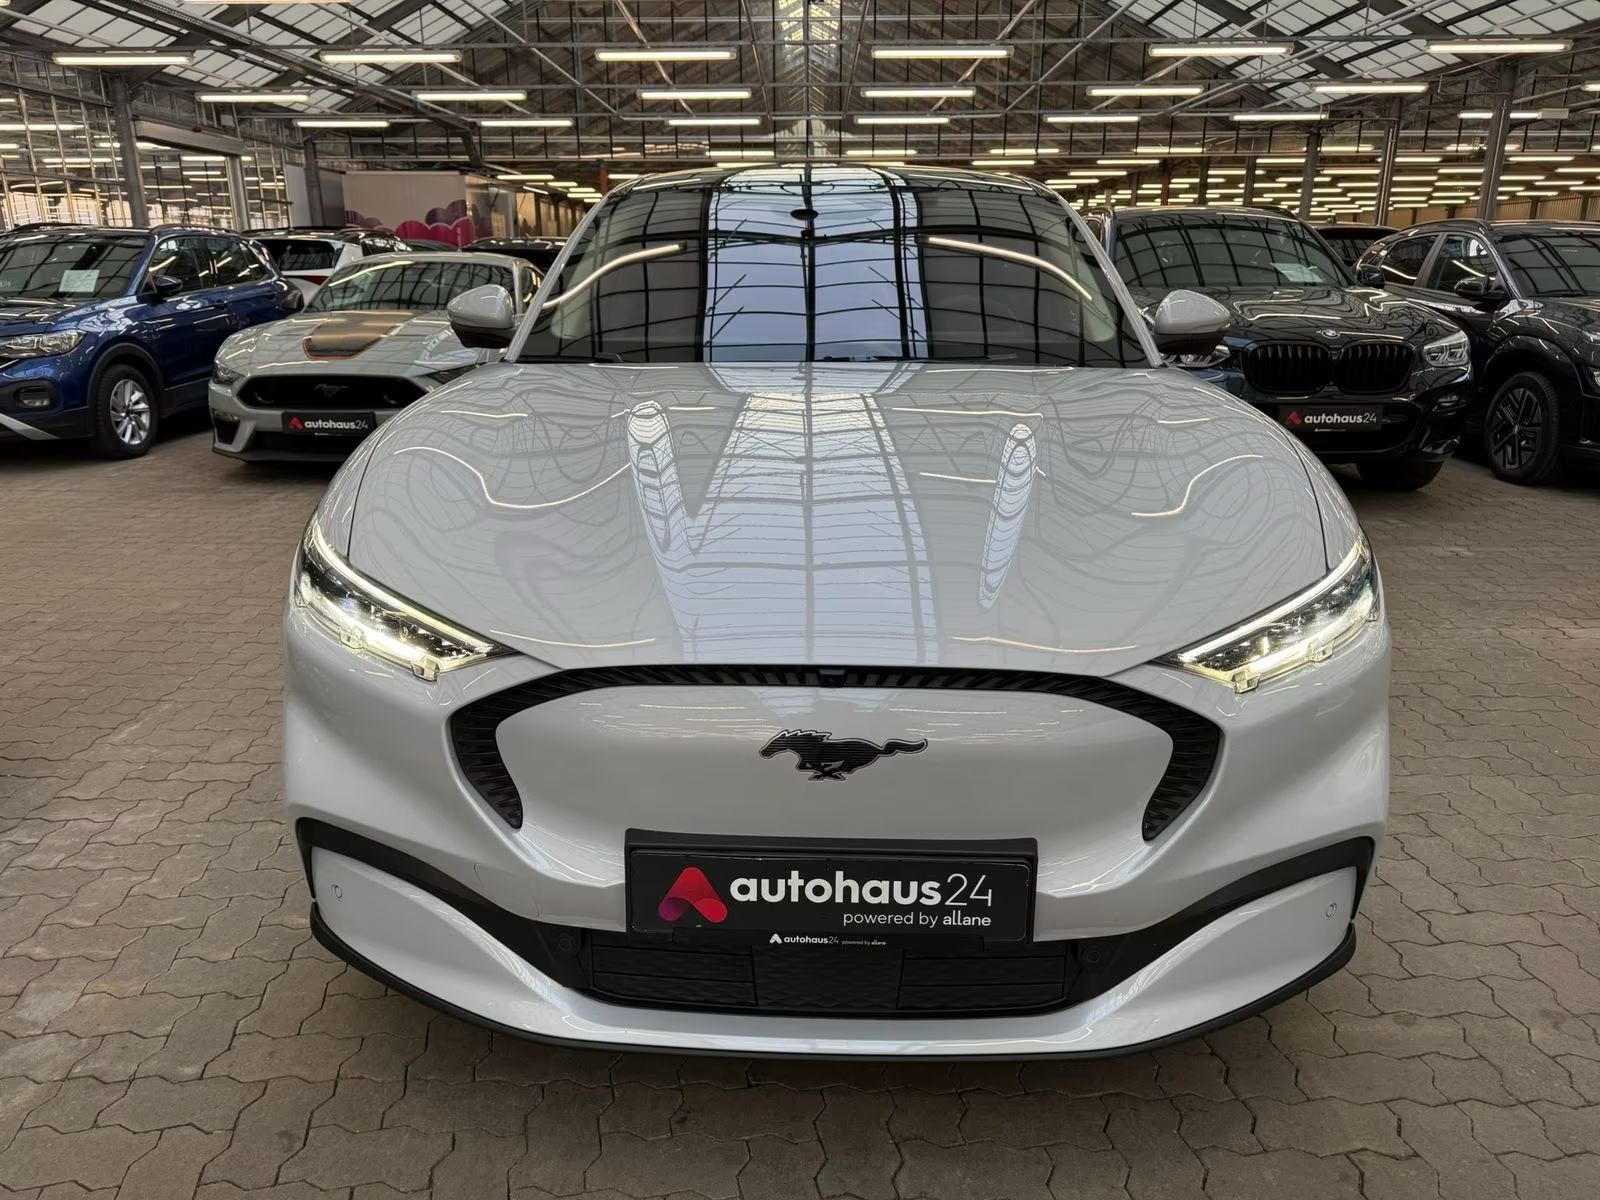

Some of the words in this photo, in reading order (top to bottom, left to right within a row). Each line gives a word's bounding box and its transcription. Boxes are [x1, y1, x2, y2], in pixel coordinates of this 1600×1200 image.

[1304, 412, 1377, 423] autohaus24
[304, 419, 369, 429] autohaus24
[730, 870, 992, 907] autohaus24
[843, 911, 914, 927] powered
[919, 911, 938, 928] by
[942, 910, 992, 927] allane
[783, 935, 839, 944] autohaus24
